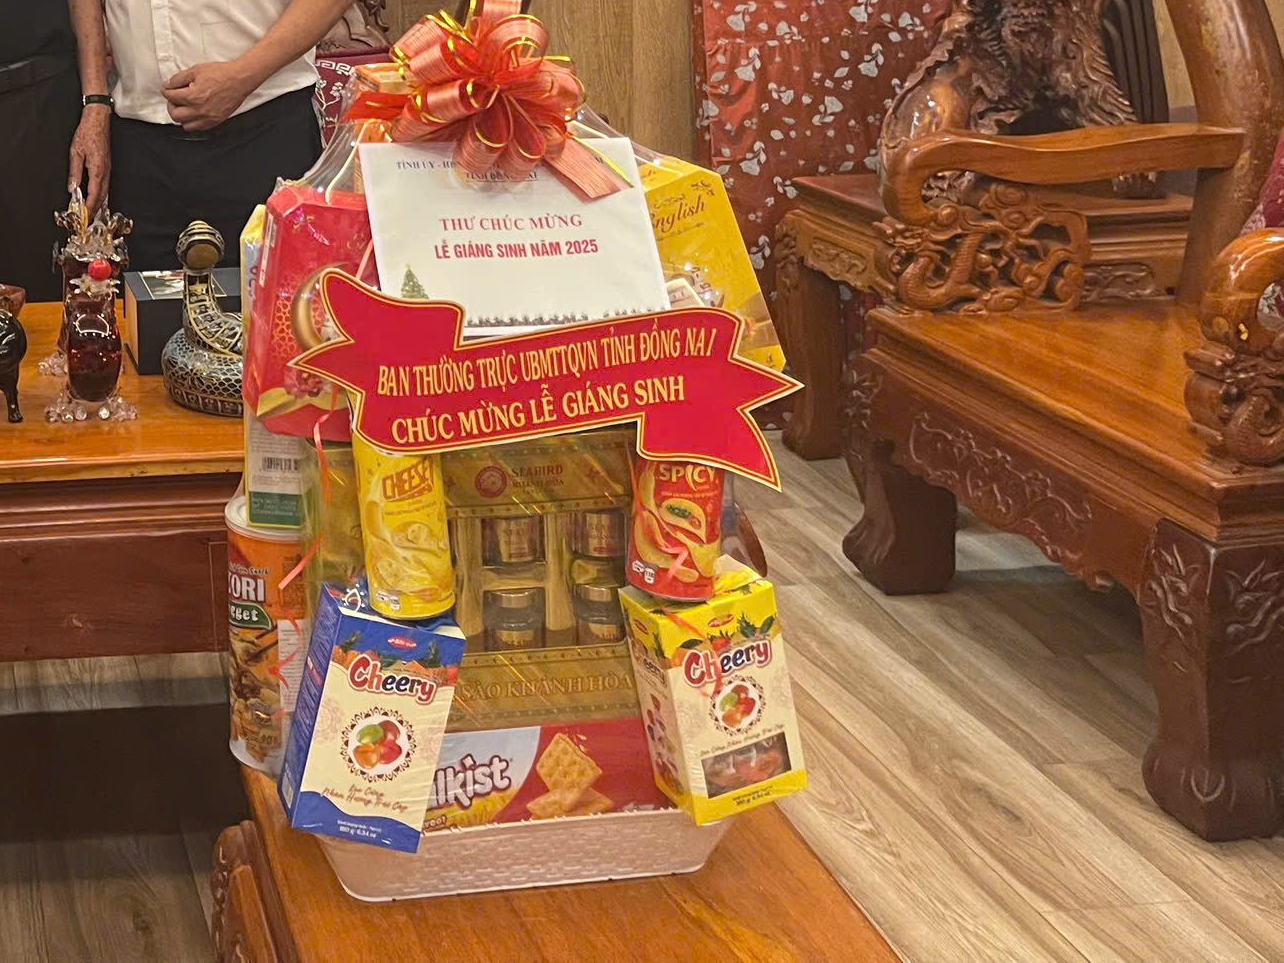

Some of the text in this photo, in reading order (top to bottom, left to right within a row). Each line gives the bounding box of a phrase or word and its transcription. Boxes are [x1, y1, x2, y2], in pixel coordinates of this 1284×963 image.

[439, 212, 583, 232] THƯ CHÚC MỪNG
[434, 238, 599, 260] LỄ GIÁNG SINH NĂM 2025
[377, 318, 716, 396] BAN THƯỜNG TRỰC UBMTTQVN TỈNH ĐỒNG NAI
[391, 375, 685, 444] CHÚC MỪNG LỄ GIÁNG SINH
[659, 464, 716, 491] SPICY
[349, 654, 436, 704] Cheery
[685, 639, 771, 685] Cheery
[426, 754, 511, 807] lkist
